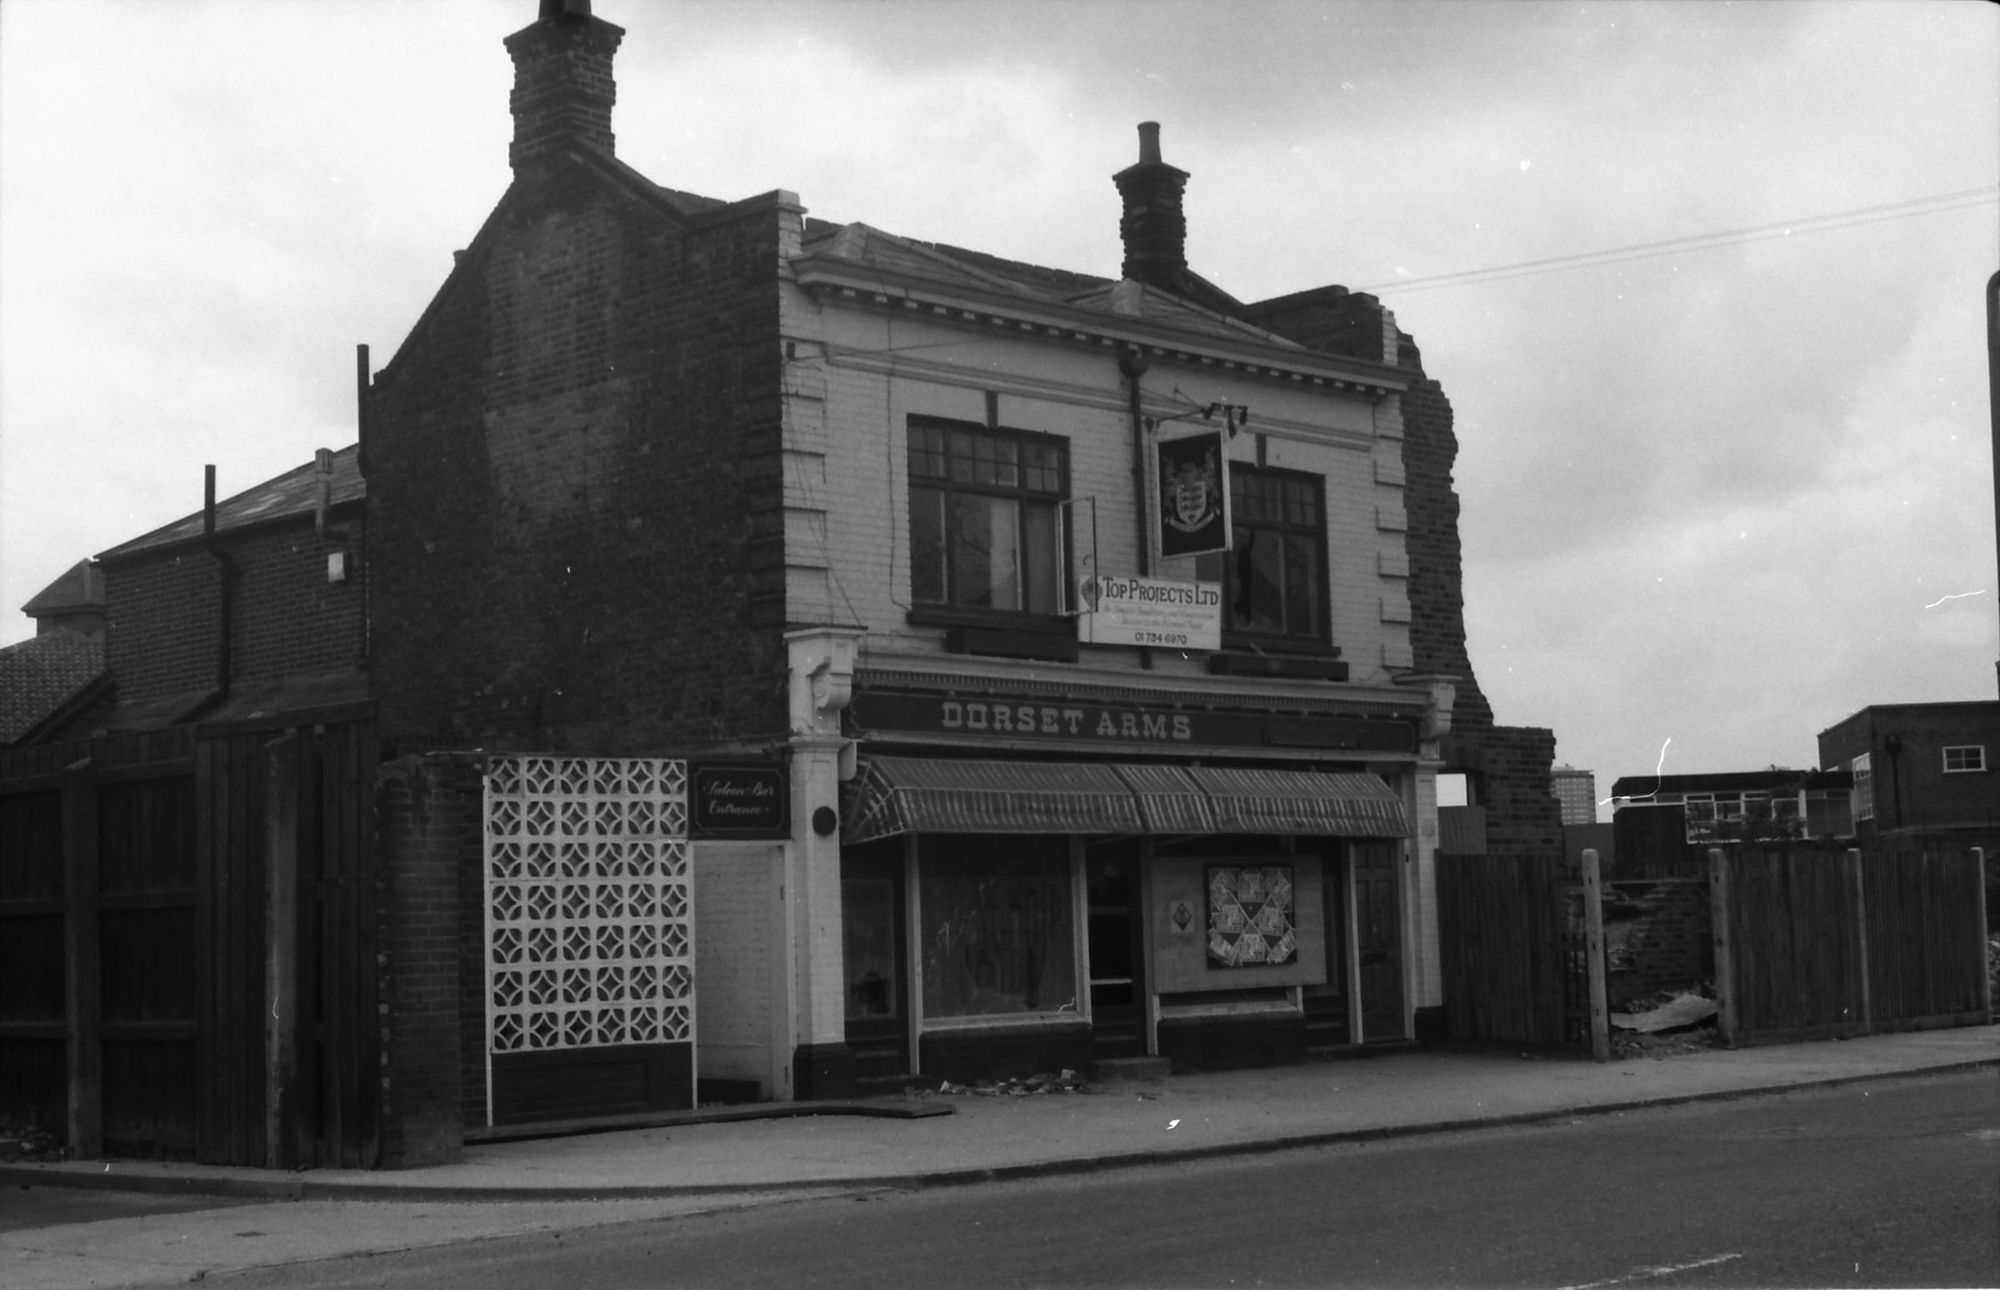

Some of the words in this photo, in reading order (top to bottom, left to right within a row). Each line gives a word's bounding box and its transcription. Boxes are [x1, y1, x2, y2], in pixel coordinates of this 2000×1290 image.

[1103, 577, 1127, 598] TOP
[1129, 579, 1193, 604] PROJECTS
[1195, 585, 1219, 606] LTD
[1134, 631, 1144, 642] 01
[1146, 632, 1163, 643] 734
[942, 702, 1084, 735] DORSET
[1096, 711, 1192, 739] ARMS
[707, 780, 744, 796] Saloon
[750, 780, 774, 797] Bar
[708, 799, 760, 815] Entrance
